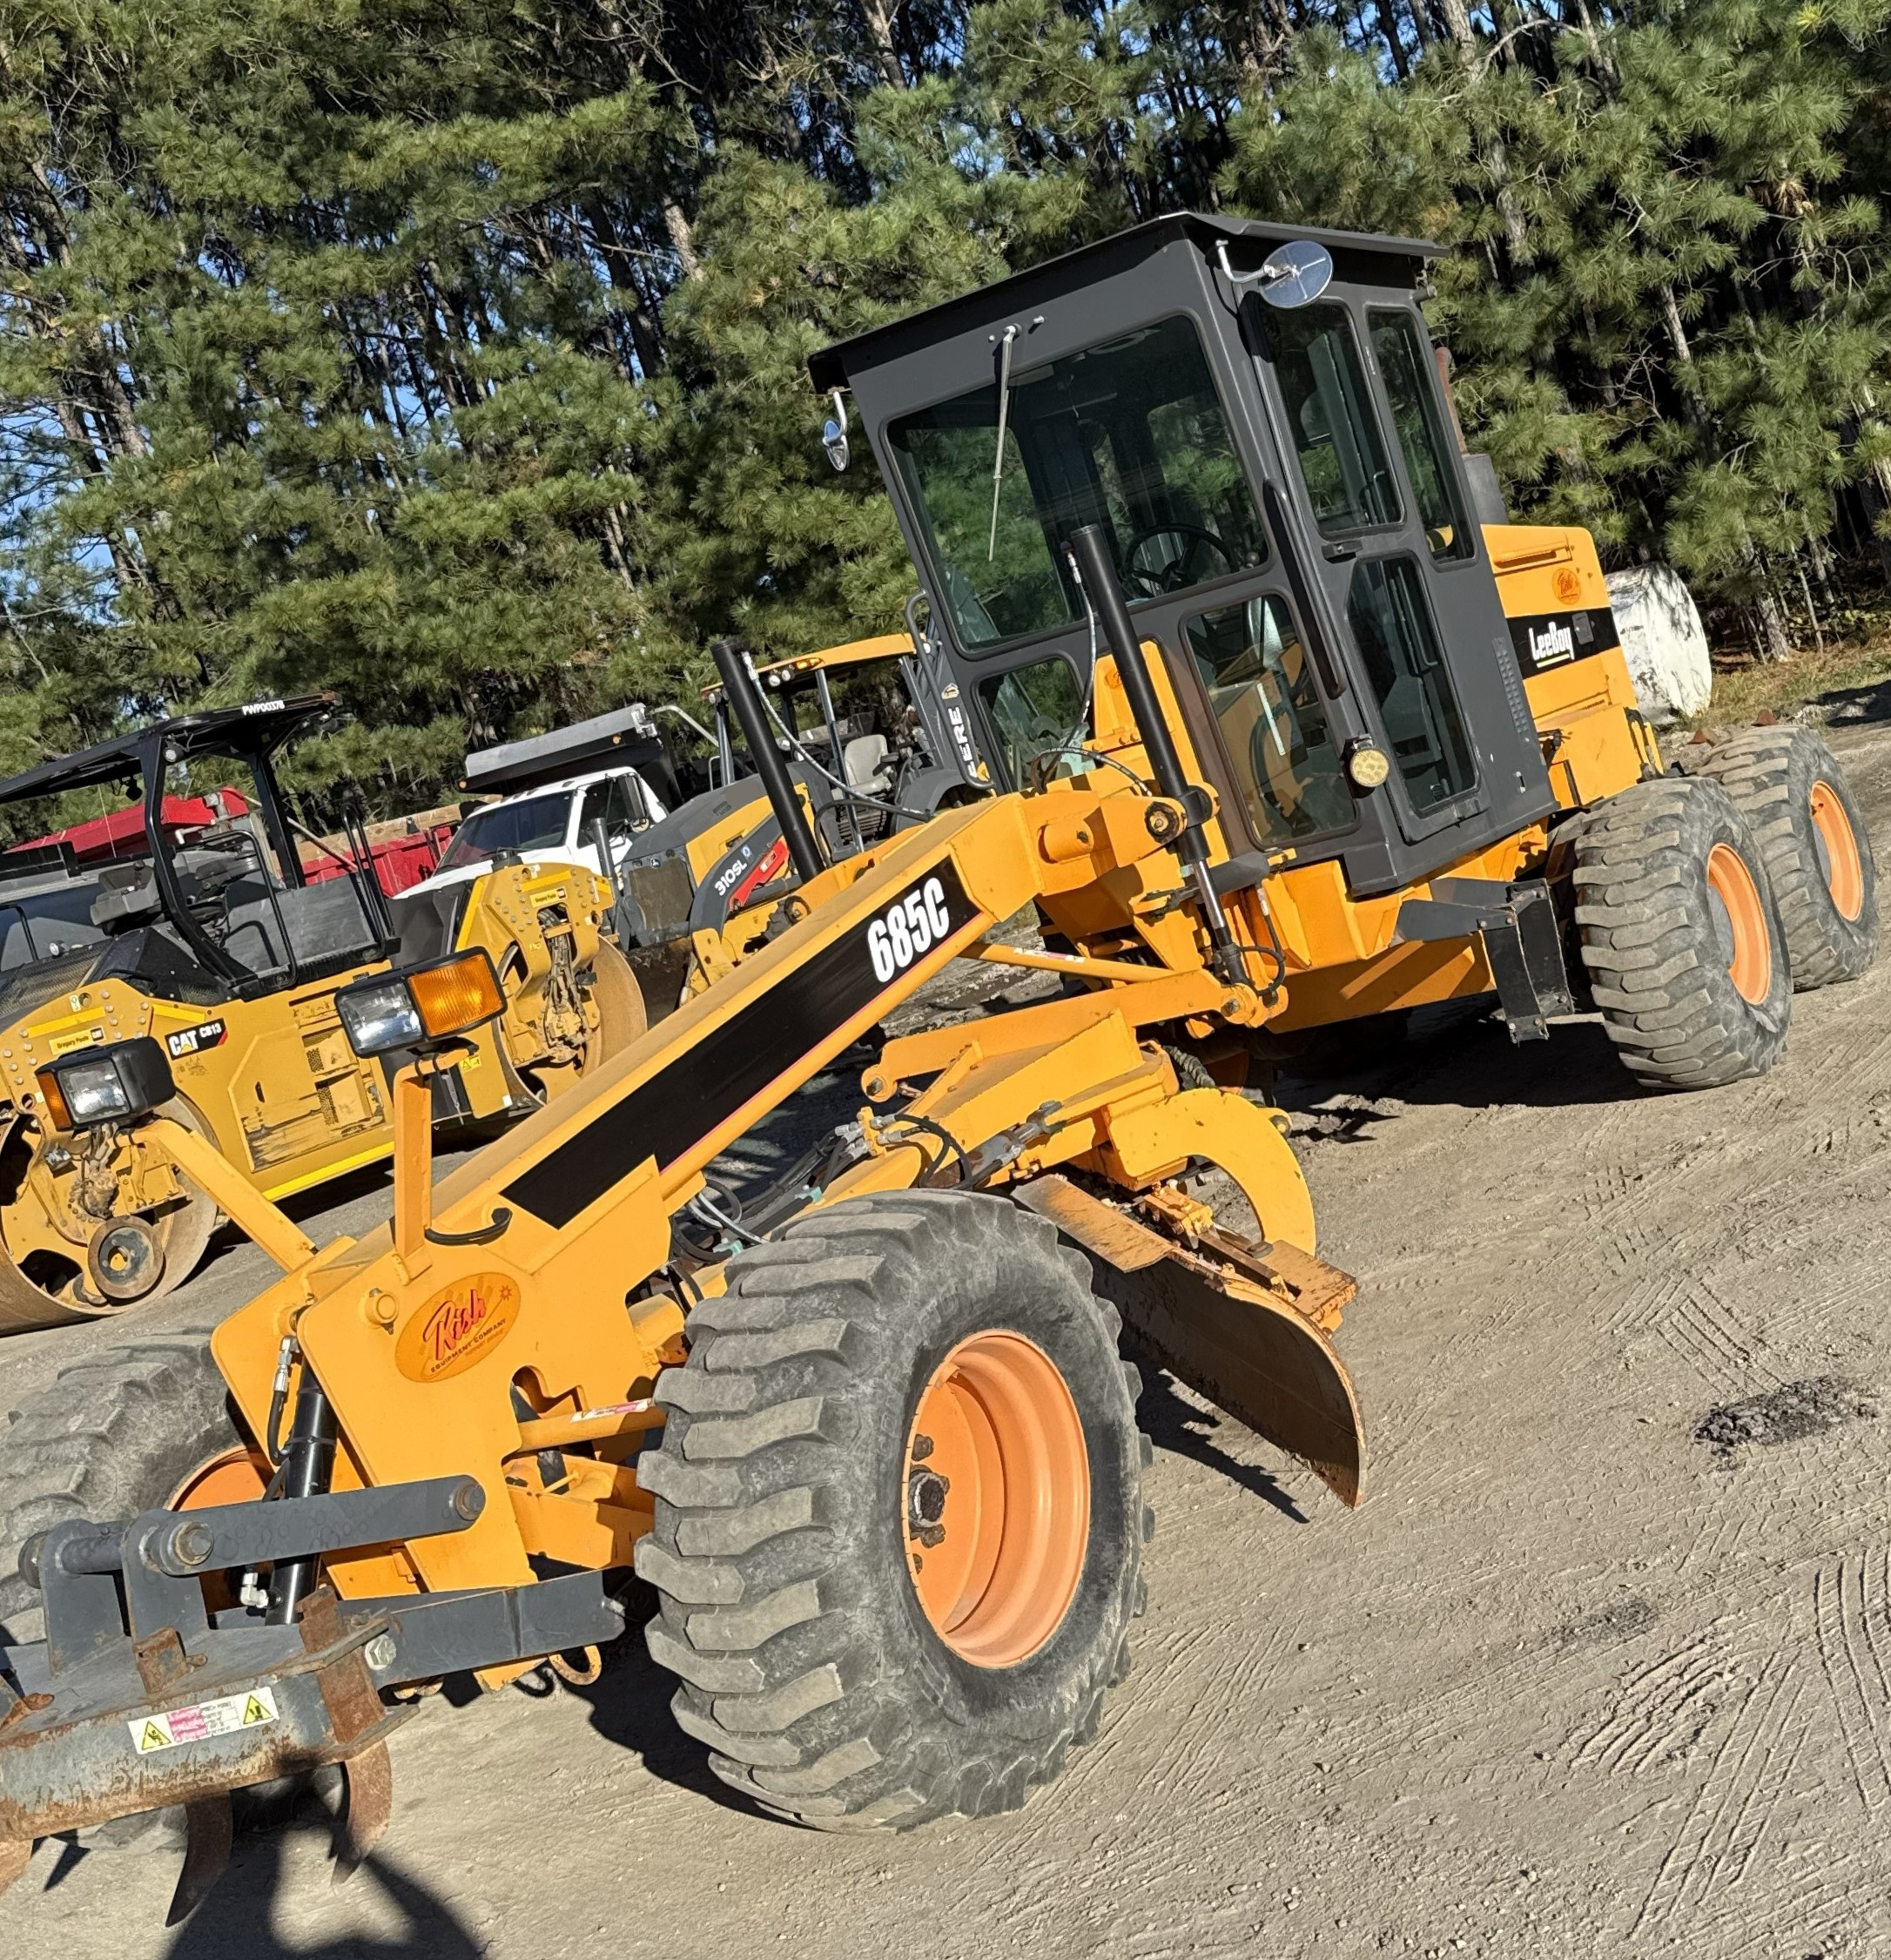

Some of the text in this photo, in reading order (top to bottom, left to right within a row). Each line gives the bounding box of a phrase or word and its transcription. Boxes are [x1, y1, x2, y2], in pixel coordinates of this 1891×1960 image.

[1529, 621, 1575, 661] LeeBoy
[715, 859, 747, 896] 310SL
[868, 877, 949, 982] 685C
[168, 1030, 199, 1055] CAT
[431, 1341, 472, 1372] EQUIPMENT
[474, 1318, 506, 1344] COMPANY
